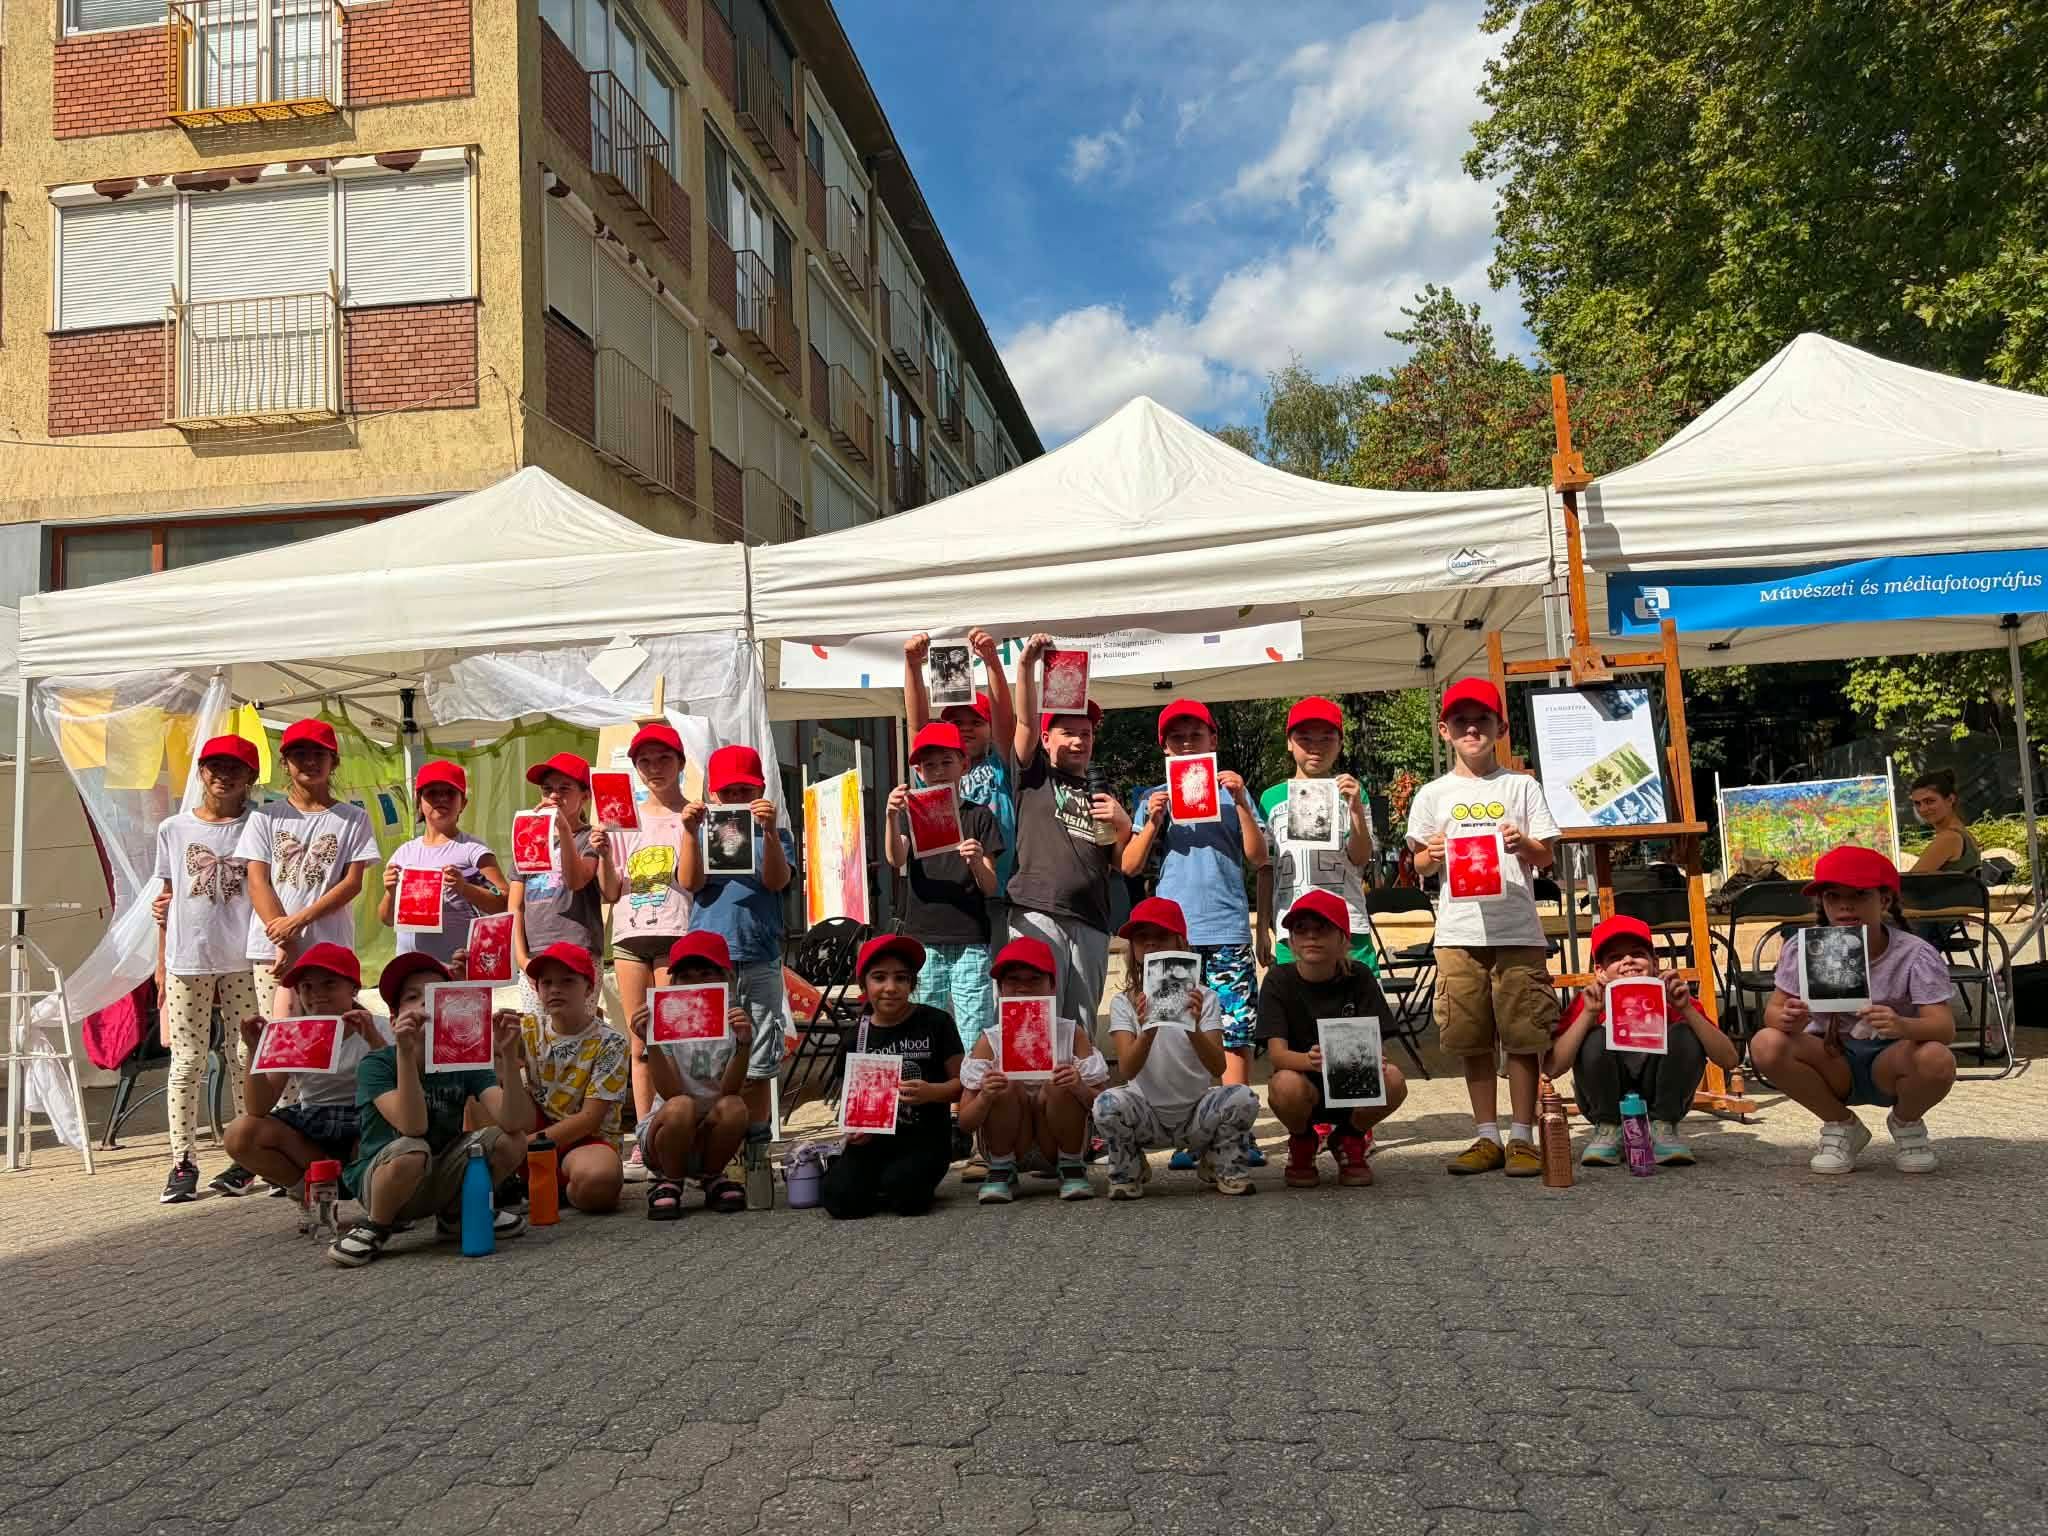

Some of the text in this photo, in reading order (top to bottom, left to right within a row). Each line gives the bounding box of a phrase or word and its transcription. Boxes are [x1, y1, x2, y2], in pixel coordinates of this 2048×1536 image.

[1759, 570, 2043, 602] Művészeti és médiafotográfus
